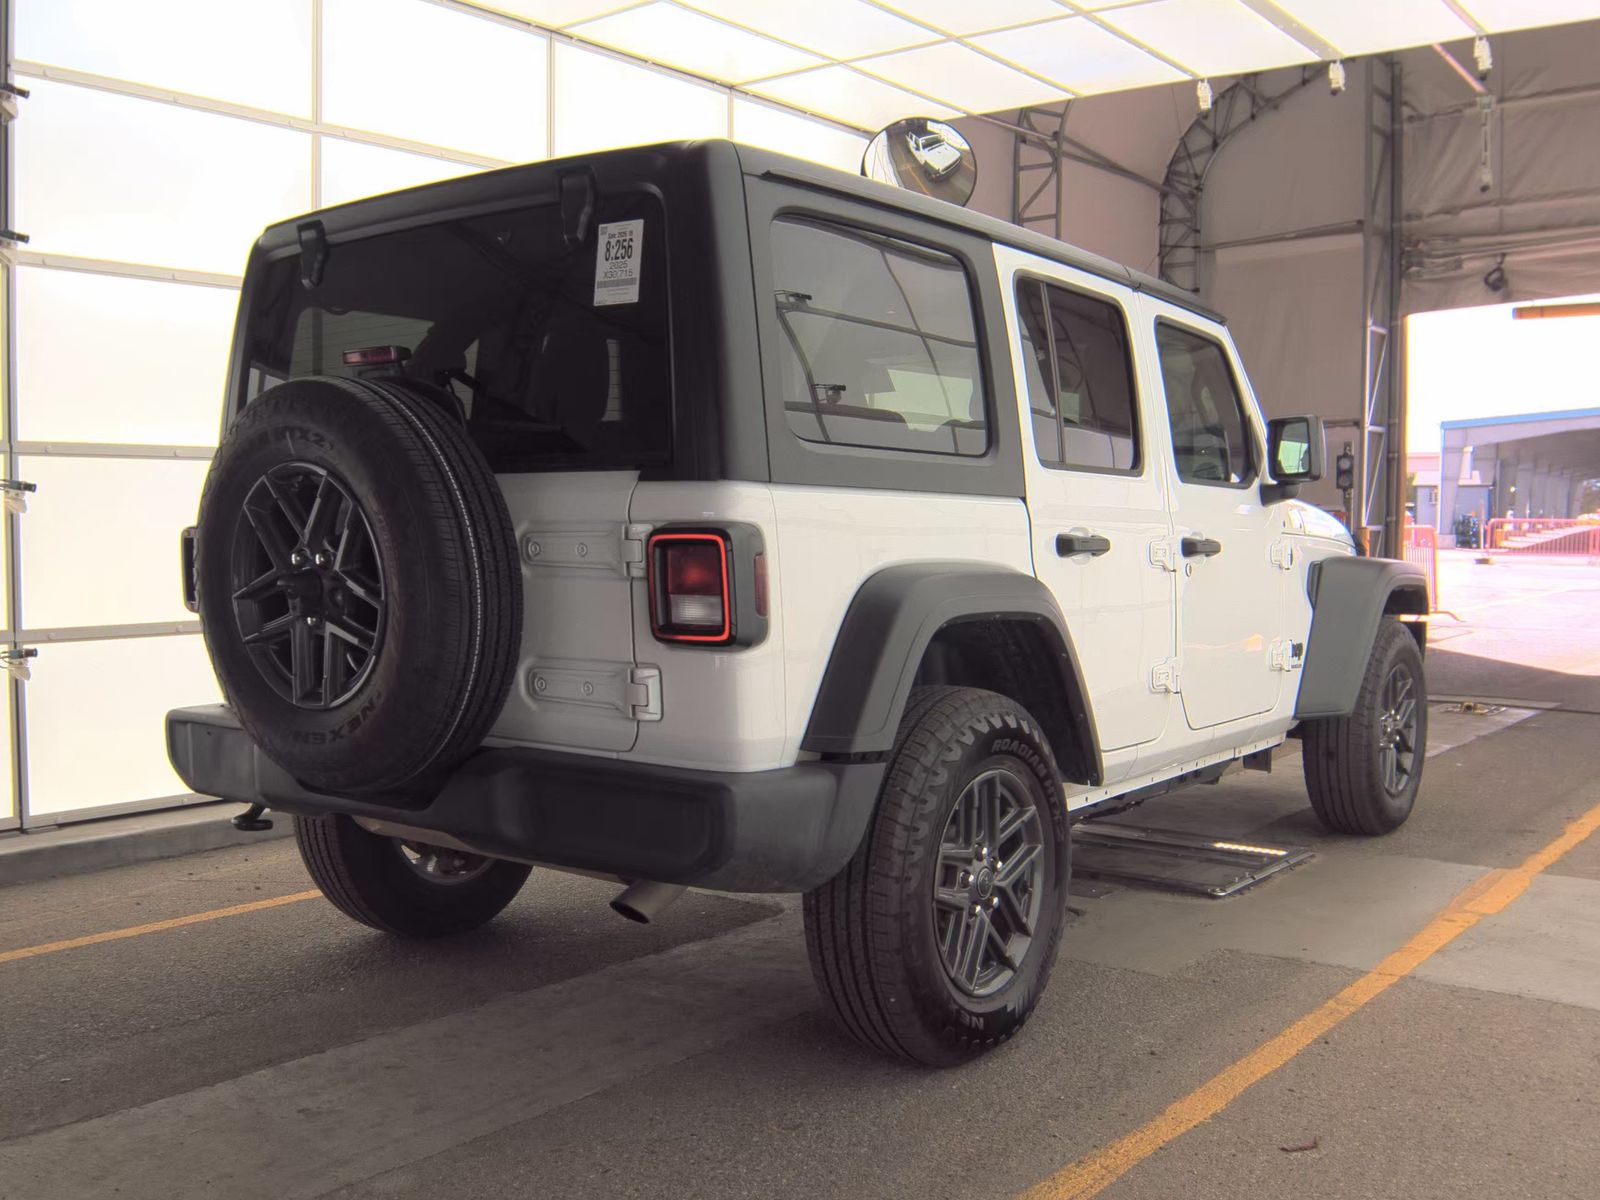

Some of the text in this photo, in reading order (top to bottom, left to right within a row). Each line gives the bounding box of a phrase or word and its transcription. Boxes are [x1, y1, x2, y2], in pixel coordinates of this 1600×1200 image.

[605, 238, 633, 261] 8:256
[609, 260, 628, 269] 2025
[292, 698, 376, 745] NEXEN
[992, 738, 1047, 777] ROADIAN
